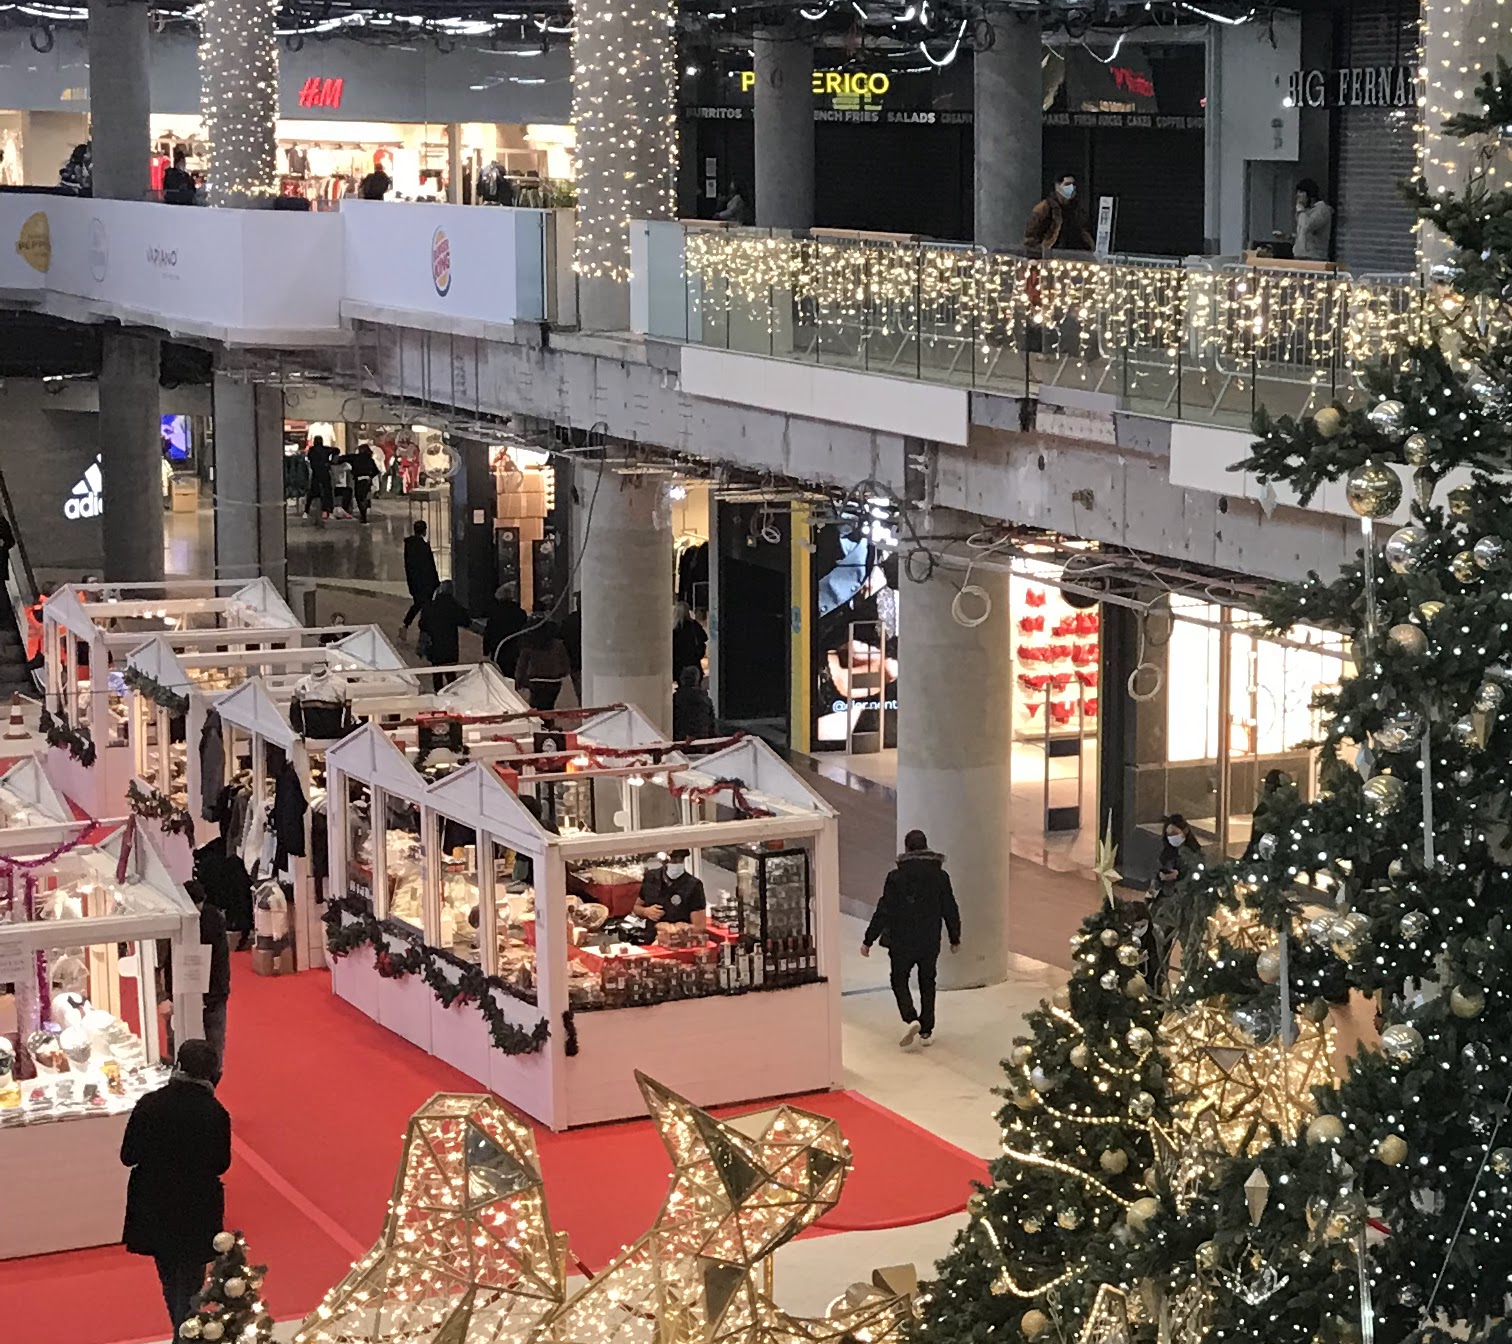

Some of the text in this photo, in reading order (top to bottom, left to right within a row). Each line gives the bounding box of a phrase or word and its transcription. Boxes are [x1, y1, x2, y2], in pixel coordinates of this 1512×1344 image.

[298, 76, 344, 109] H&M
[1289, 67, 1417, 107] BIG FERNAN
[814, 110, 842, 122] ENCH
[845, 111, 879, 123] FRIES
[887, 112, 936, 124] SALADS
[64, 492, 103, 519] adi
